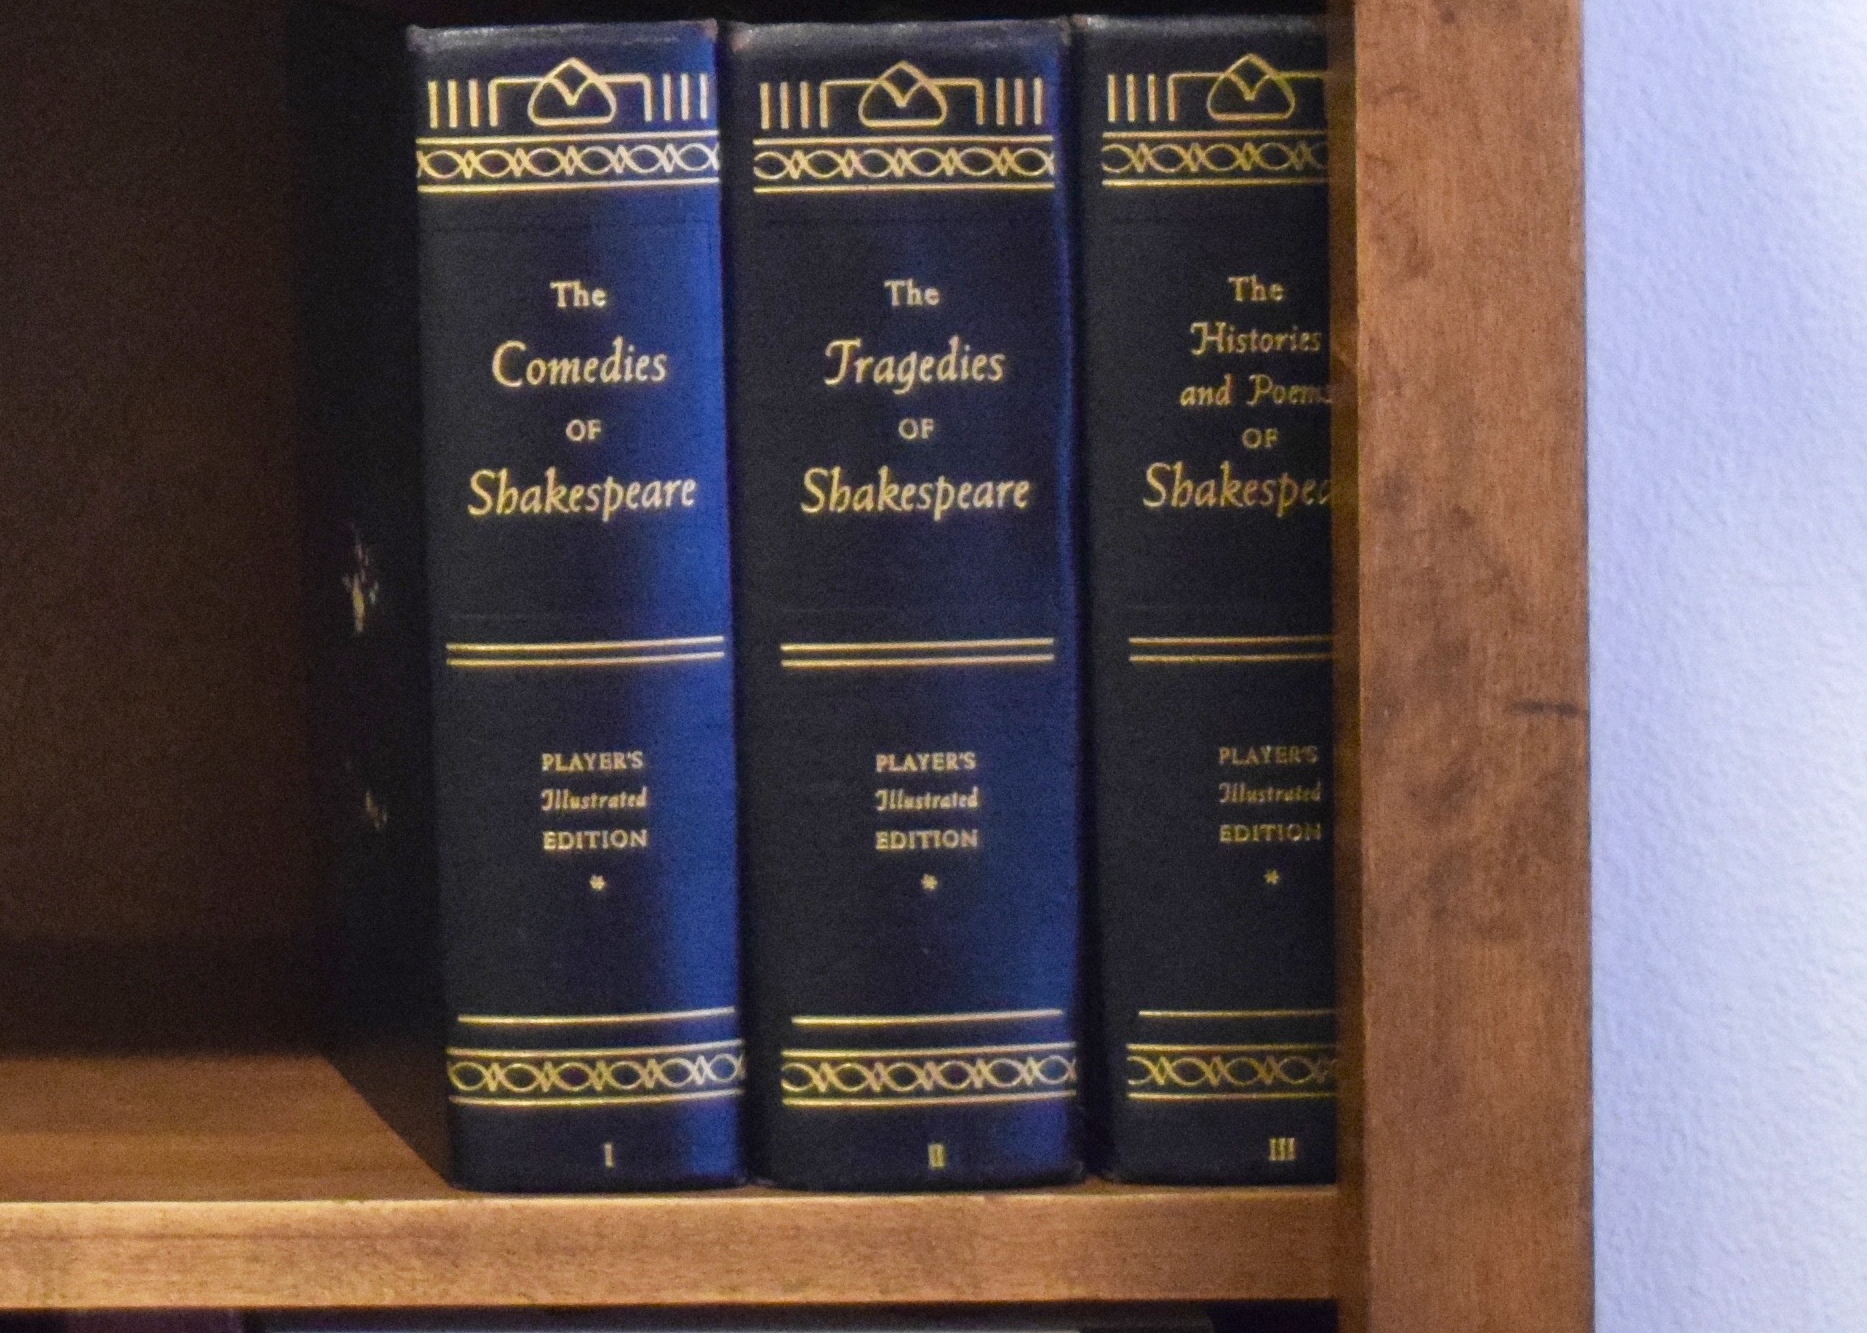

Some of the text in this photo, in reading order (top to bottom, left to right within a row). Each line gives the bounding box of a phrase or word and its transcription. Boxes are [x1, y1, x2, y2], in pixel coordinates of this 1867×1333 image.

[549, 280, 608, 310] The
[884, 279, 941, 309] The
[1228, 274, 1286, 304] The
[1190, 320, 1323, 356] Histories
[492, 337, 668, 389] Comedies
[823, 337, 1004, 395] Tragedies
[1179, 375, 1233, 406] and
[565, 417, 603, 443] OF
[898, 415, 935, 441] OF
[1242, 425, 1279, 452] OF
[468, 466, 698, 521] Shakespeare
[800, 466, 1032, 520] Shakespeare
[541, 750, 643, 772] PLAYER'S
[875, 751, 977, 773] PLAYER'S
[1218, 746, 1319, 765] PLAYER'S
[541, 786, 648, 810] Illustrated
[875, 785, 979, 813] Illustrated
[1218, 778, 1322, 804] Illustrated
[542, 829, 648, 851] EDITION
[875, 828, 979, 850] EDITION
[1219, 823, 1322, 844] EDITION
[1268, 1137, 1296, 1162] III
